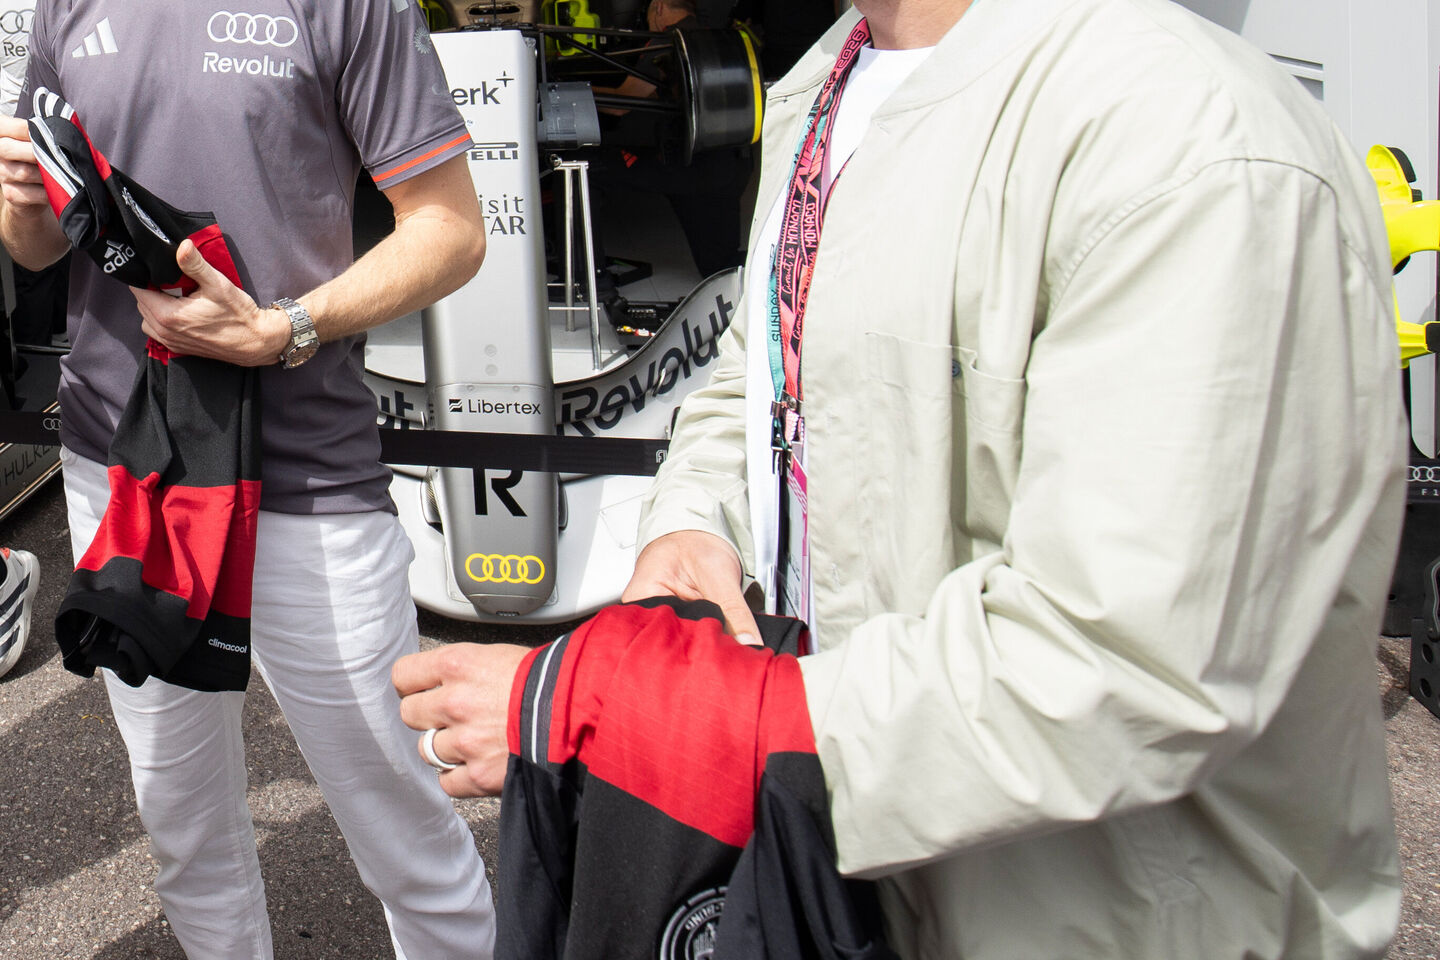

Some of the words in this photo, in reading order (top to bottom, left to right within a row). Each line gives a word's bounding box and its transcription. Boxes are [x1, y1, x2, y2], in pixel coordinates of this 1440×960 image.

[202, 51, 295, 79] Revolut
[466, 150, 519, 161] ELLI
[478, 194, 524, 214] isit
[786, 199, 802, 245] MONACO
[804, 202, 818, 248] MONACO
[771, 290, 780, 342] SUNDAY
[556, 294, 734, 438] Revolut
[468, 399, 541, 415] Libertex
[208, 637, 248, 655] climacool
